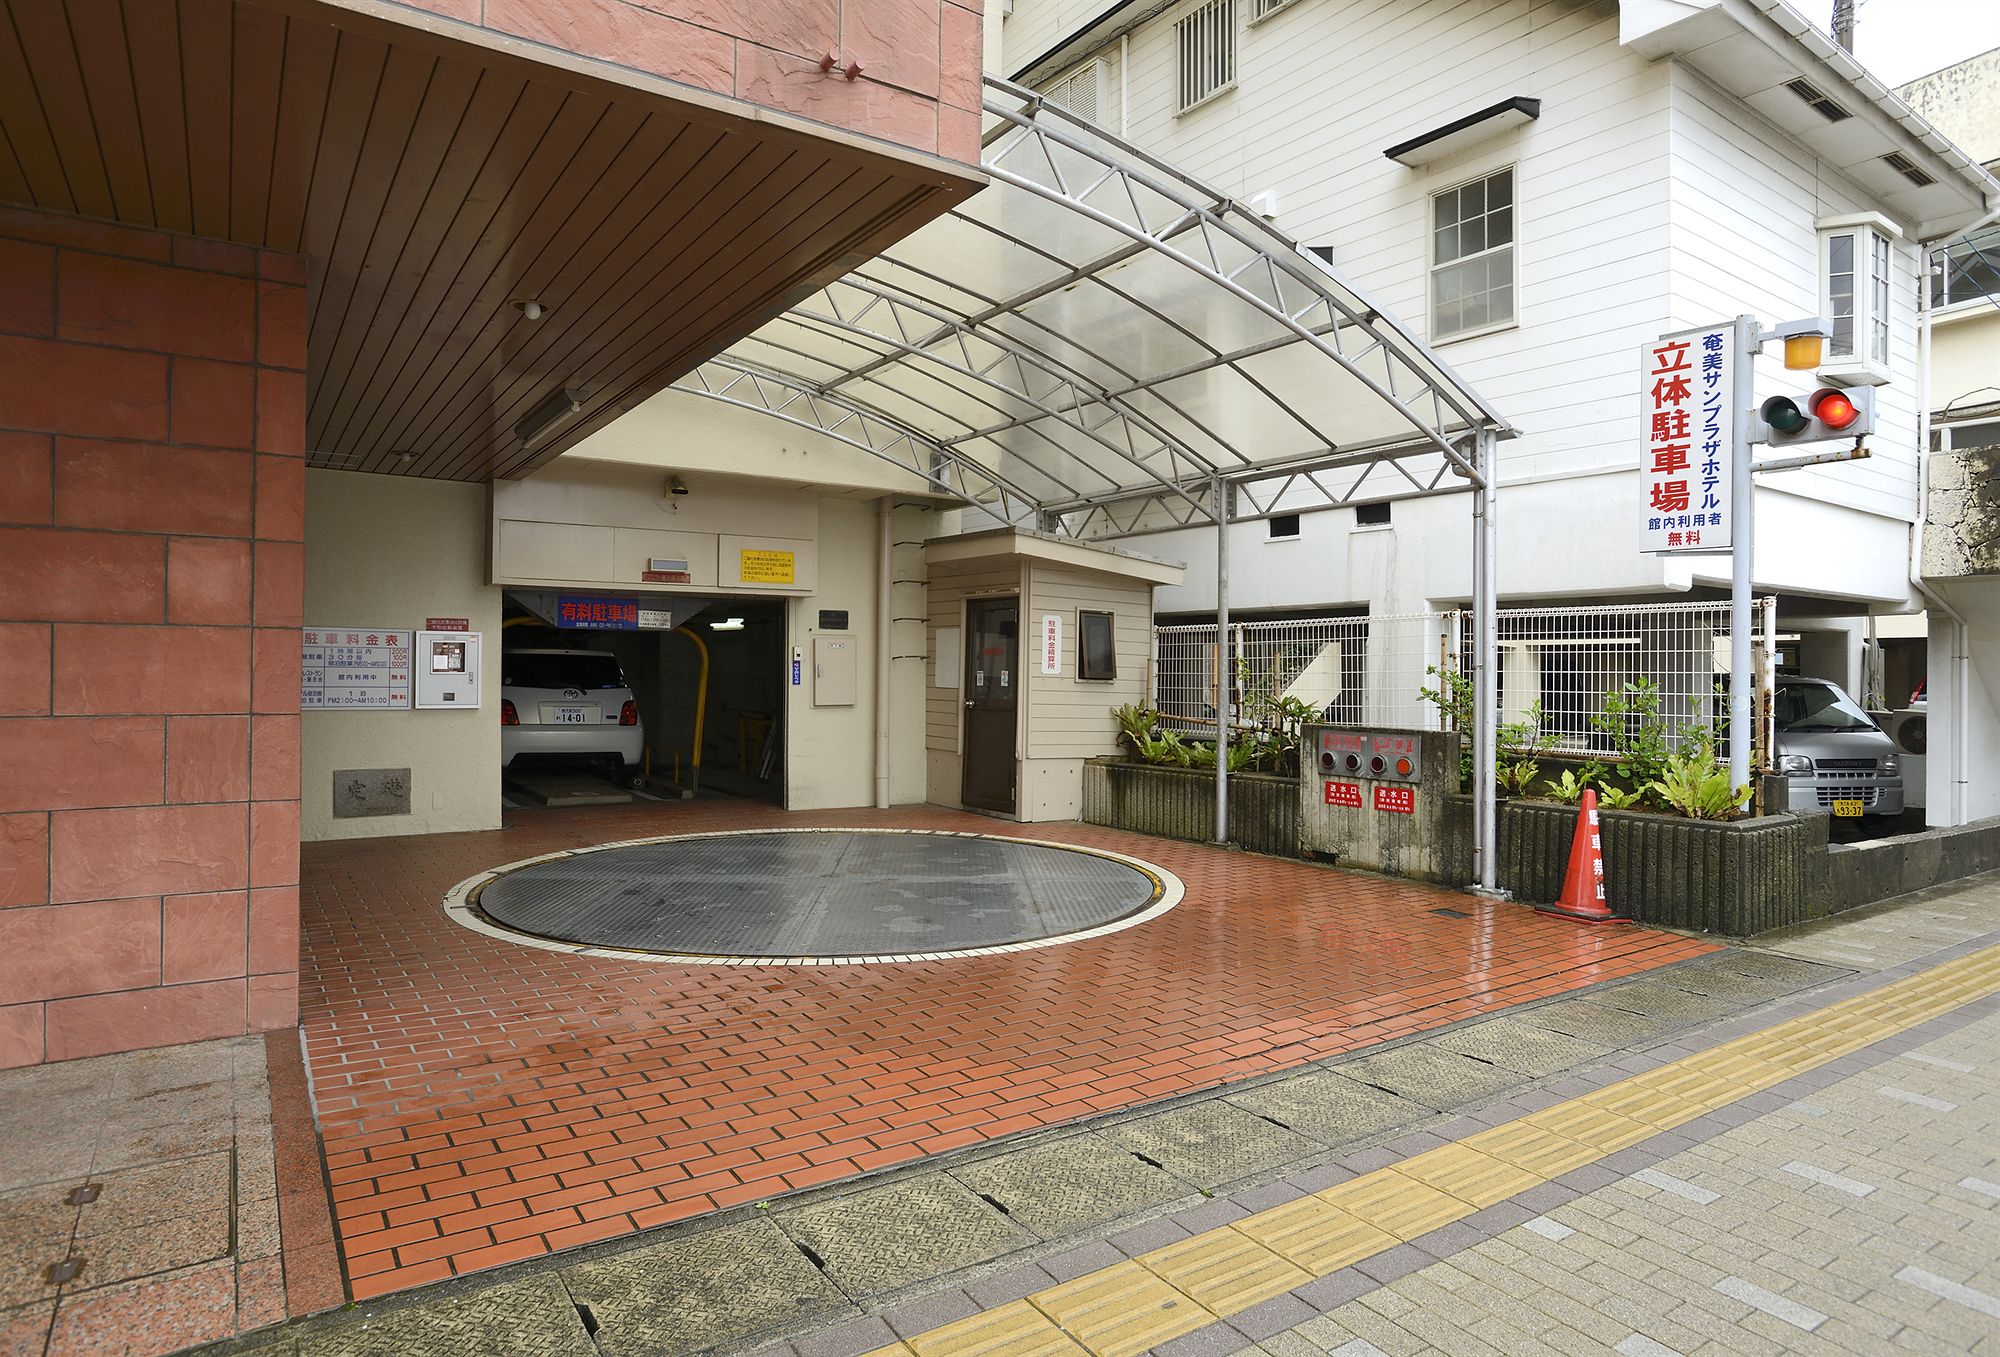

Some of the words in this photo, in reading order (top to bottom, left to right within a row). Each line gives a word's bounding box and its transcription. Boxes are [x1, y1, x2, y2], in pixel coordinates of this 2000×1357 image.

[1650, 341, 1692, 513] 立体駐車場
[1701, 333, 1723, 510] 奄美サンプラザホテル
[1648, 512, 1722, 531] 館内利用者
[1667, 530, 1701, 546] 無料
[561, 602, 637, 622] 有料駐車場
[304, 632, 398, 646] 駐車料金表
[1047, 620, 1056, 670] 駐車料金精算所
[1329, 784, 1357, 794] 送水口
[1379, 789, 1409, 799] 送水口
[1588, 809, 1606, 900] 駐車禁止
